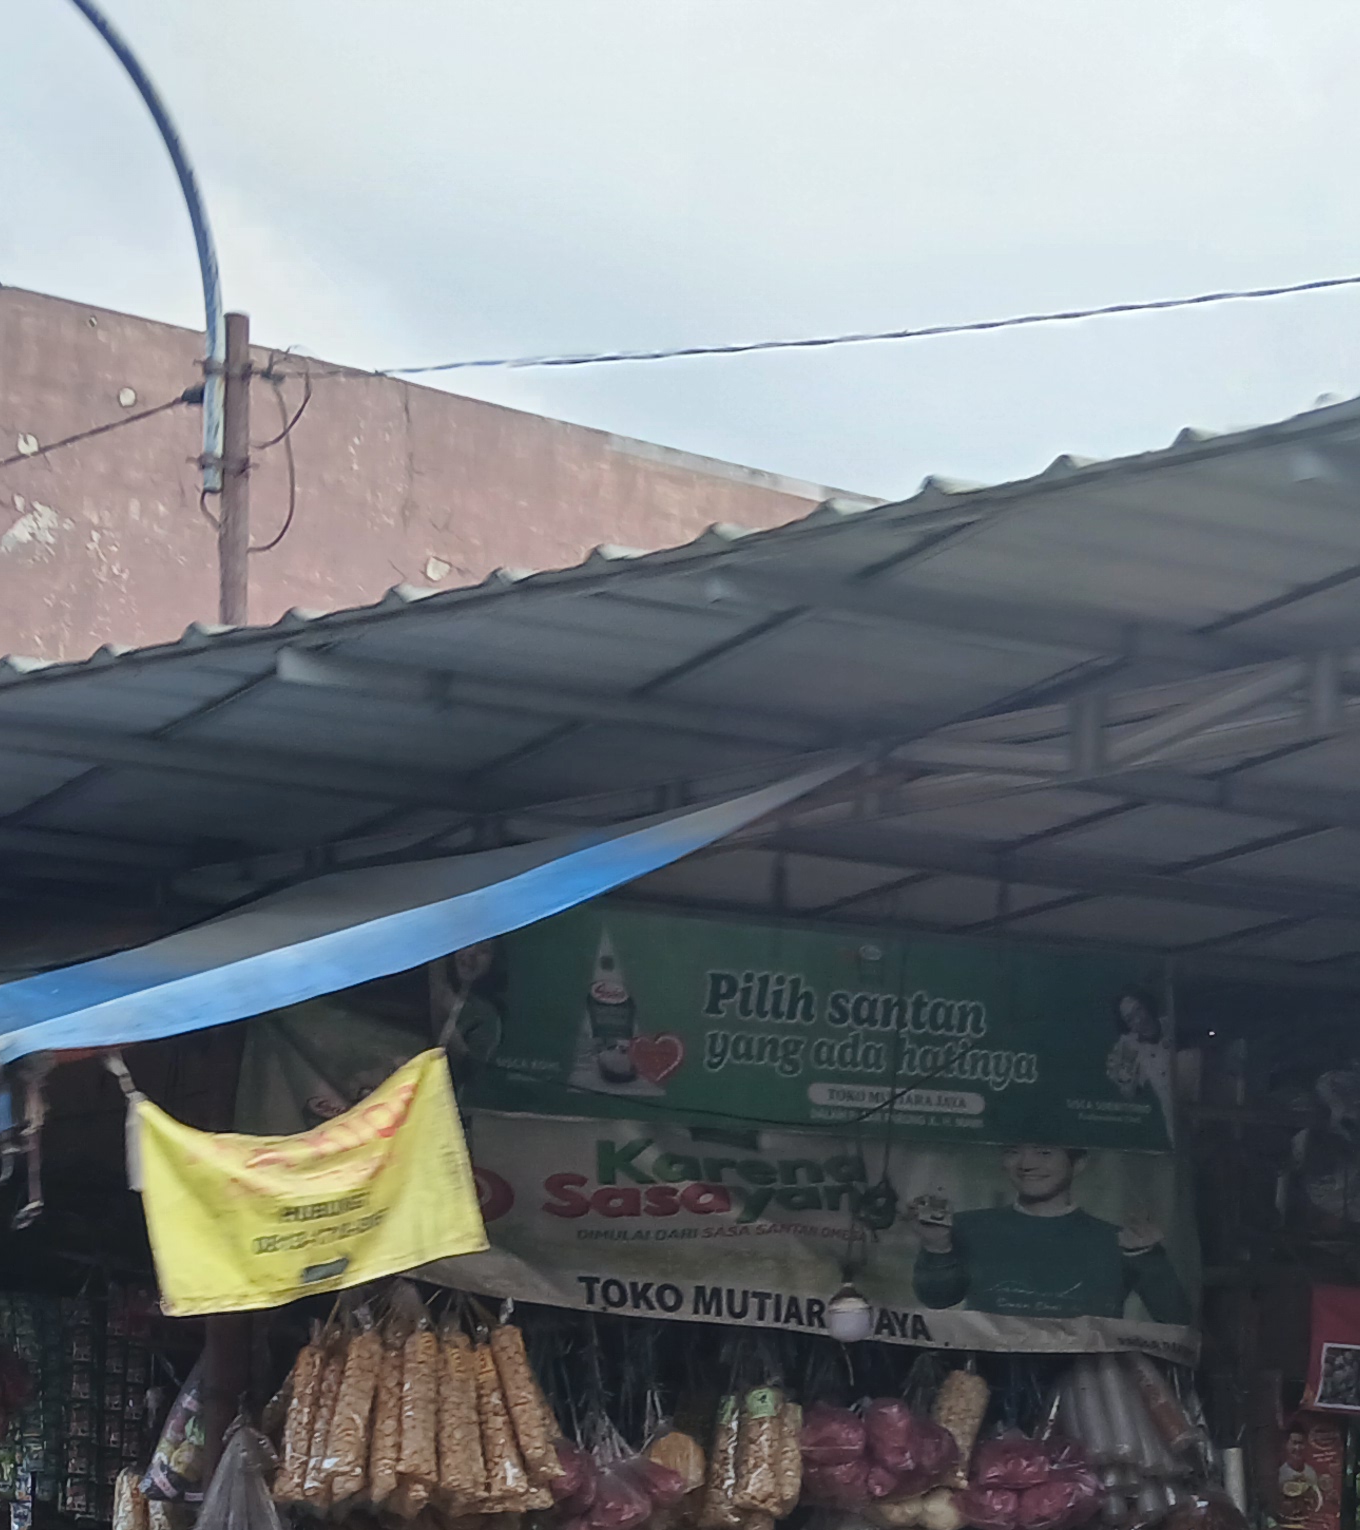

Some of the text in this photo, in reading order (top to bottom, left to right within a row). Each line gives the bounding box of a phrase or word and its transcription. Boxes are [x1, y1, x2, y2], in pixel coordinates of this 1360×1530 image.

[701, 969, 987, 1038] Pilih santan
[703, 1031, 1039, 1091] yang ada hatinya
[827, 1088, 866, 1102] TOKO
[596, 1138, 867, 1186] Karena
[576, 1228, 651, 1242] DIMULAI
[654, 1227, 698, 1241] DARI
[700, 1225, 751, 1239] SASA
[576, 1275, 934, 1342] TOKO MUTIAR AYA
